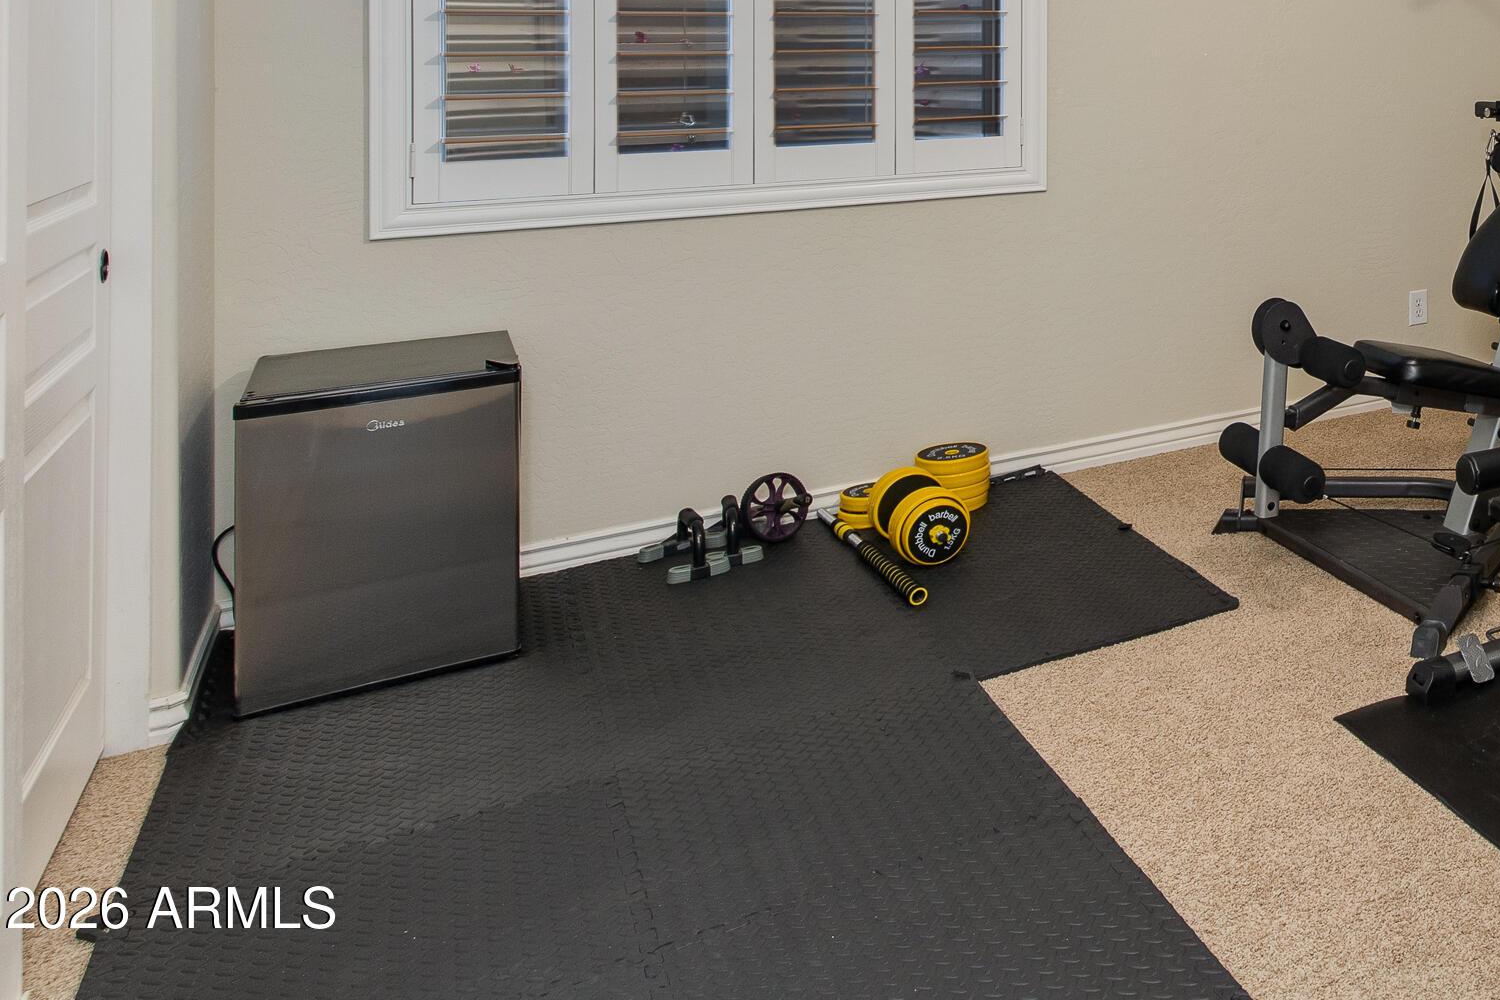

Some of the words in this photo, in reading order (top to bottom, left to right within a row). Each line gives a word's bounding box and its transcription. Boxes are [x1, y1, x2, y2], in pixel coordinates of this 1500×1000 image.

[914, 521, 937, 558] Dumbbell
[927, 509, 959, 523] barbell
[943, 527, 961, 550] 1.5KG
